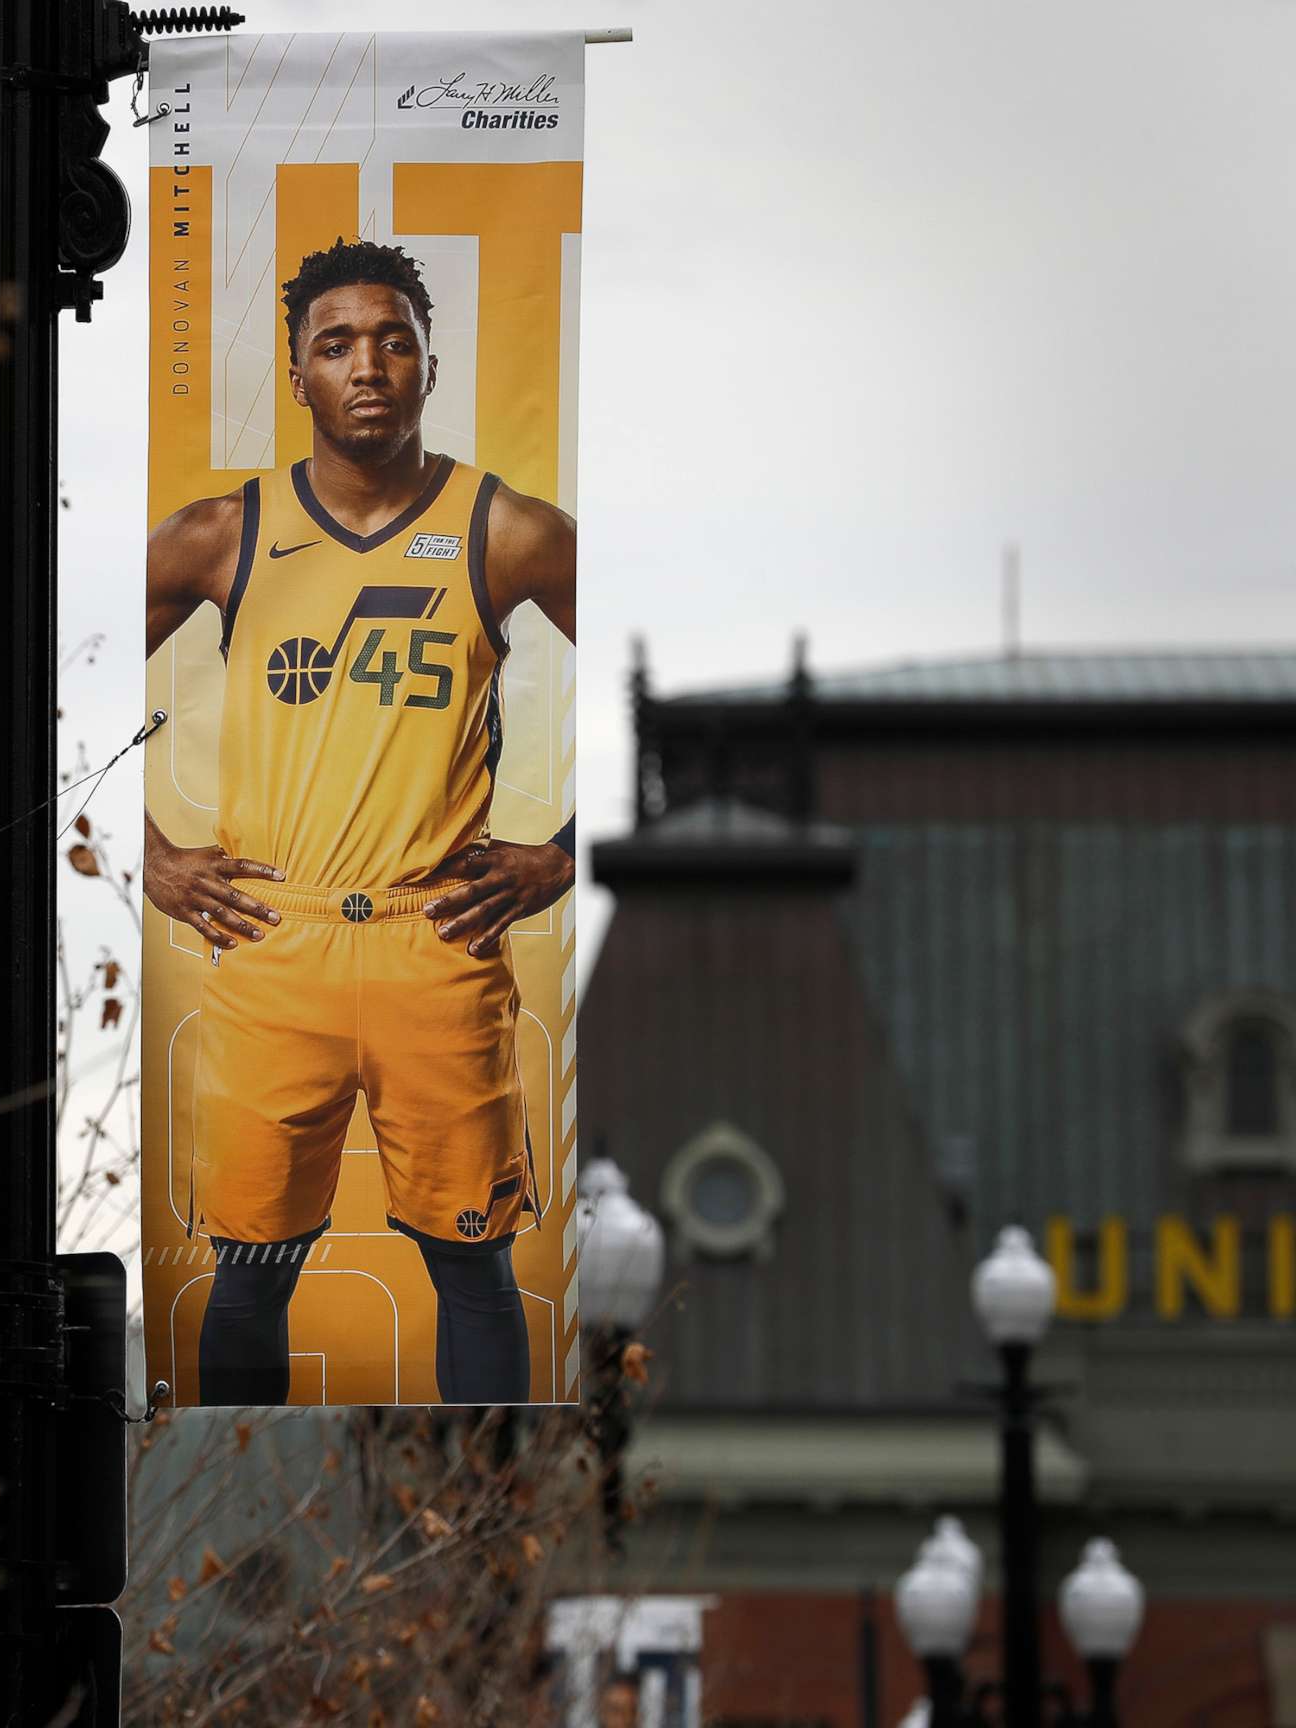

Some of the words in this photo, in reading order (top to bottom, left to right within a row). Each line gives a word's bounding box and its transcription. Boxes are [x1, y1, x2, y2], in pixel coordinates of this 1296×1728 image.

[416, 72, 475, 109] Larry
[493, 73, 560, 104] Miller
[461, 110, 559, 129] Charities
[173, 83, 191, 236] MITCHELL
[173, 259, 190, 394] DONOVAN
[411, 536, 428, 555] 5
[426, 547, 457, 557] FIGHT
[349, 629, 458, 710] 45
[1048, 1214, 1296, 1322] UNI
